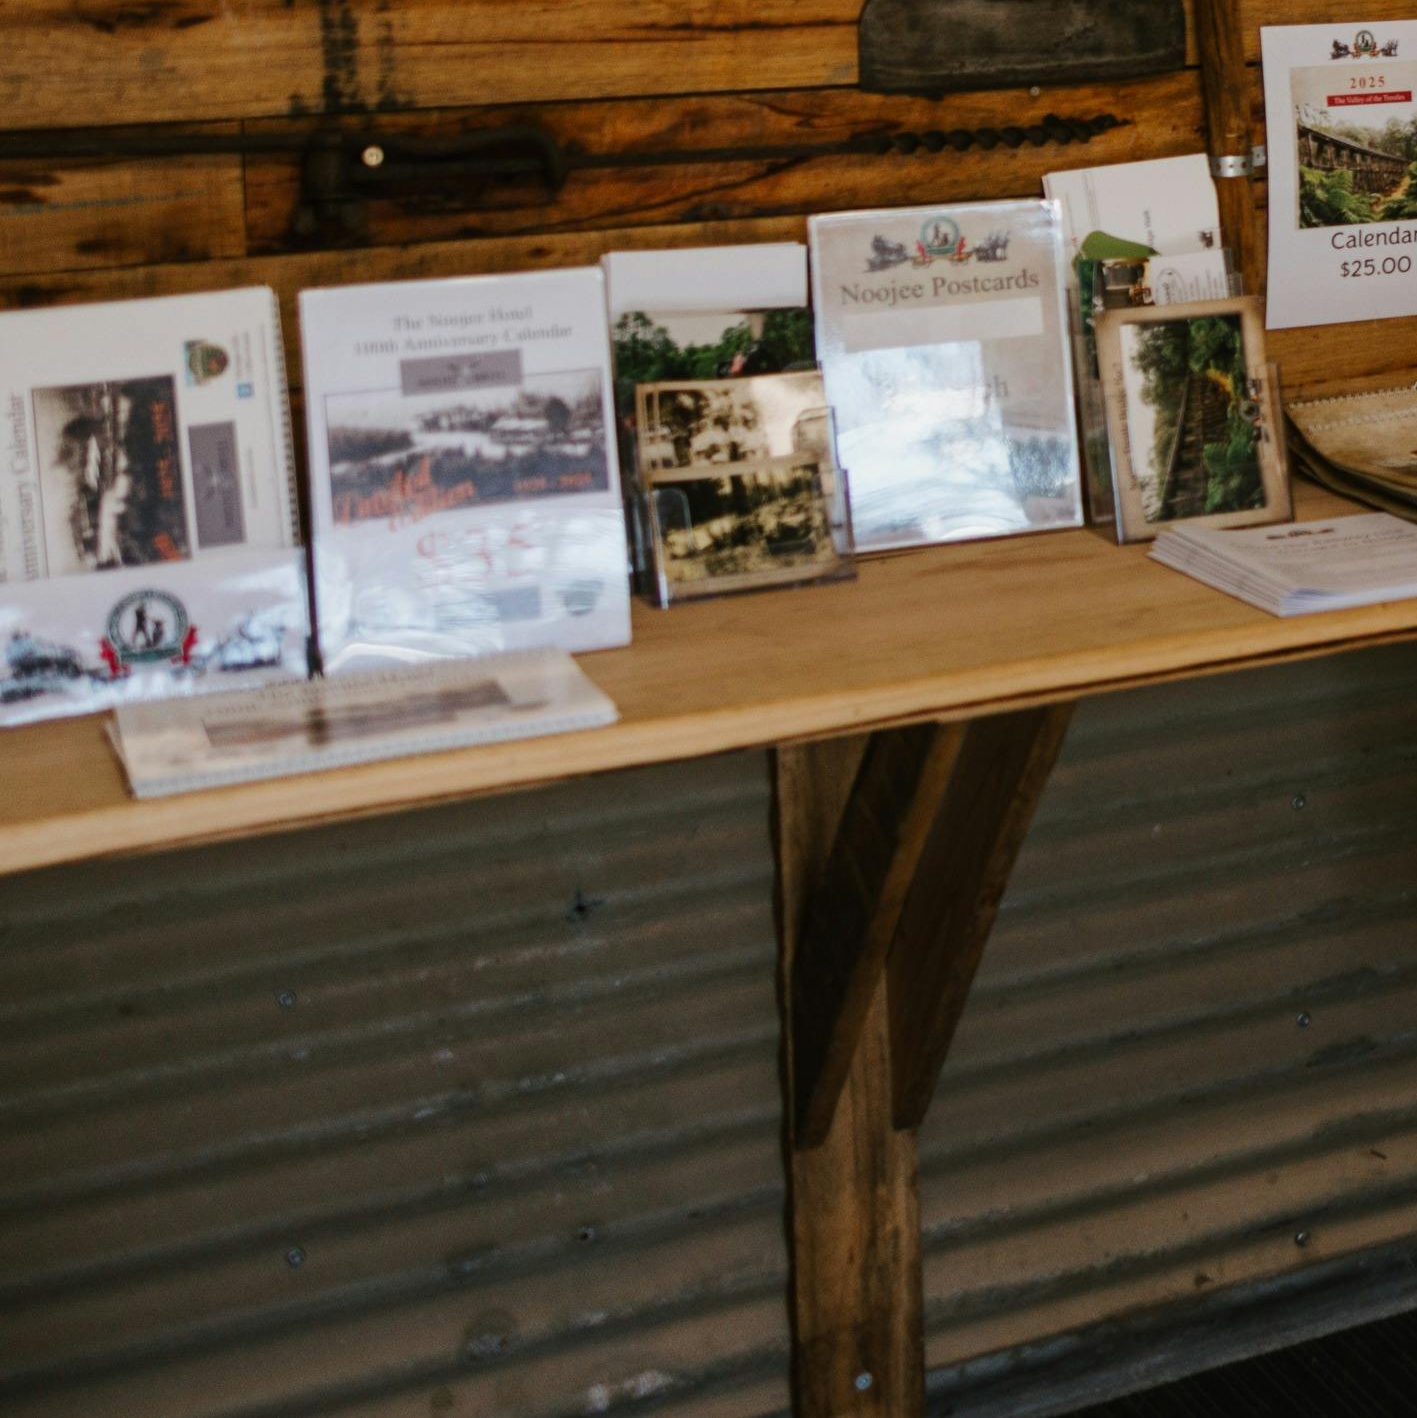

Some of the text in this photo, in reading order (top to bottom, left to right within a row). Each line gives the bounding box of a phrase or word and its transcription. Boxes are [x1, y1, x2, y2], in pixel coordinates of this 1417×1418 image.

[1350, 76, 1385, 89] 2025
[1340, 256, 1411, 278] $25.00
[840, 269, 1040, 306] Noojee Postcards
[502, 324, 574, 344] Calendar
[8, 394, 31, 475] Calendar
